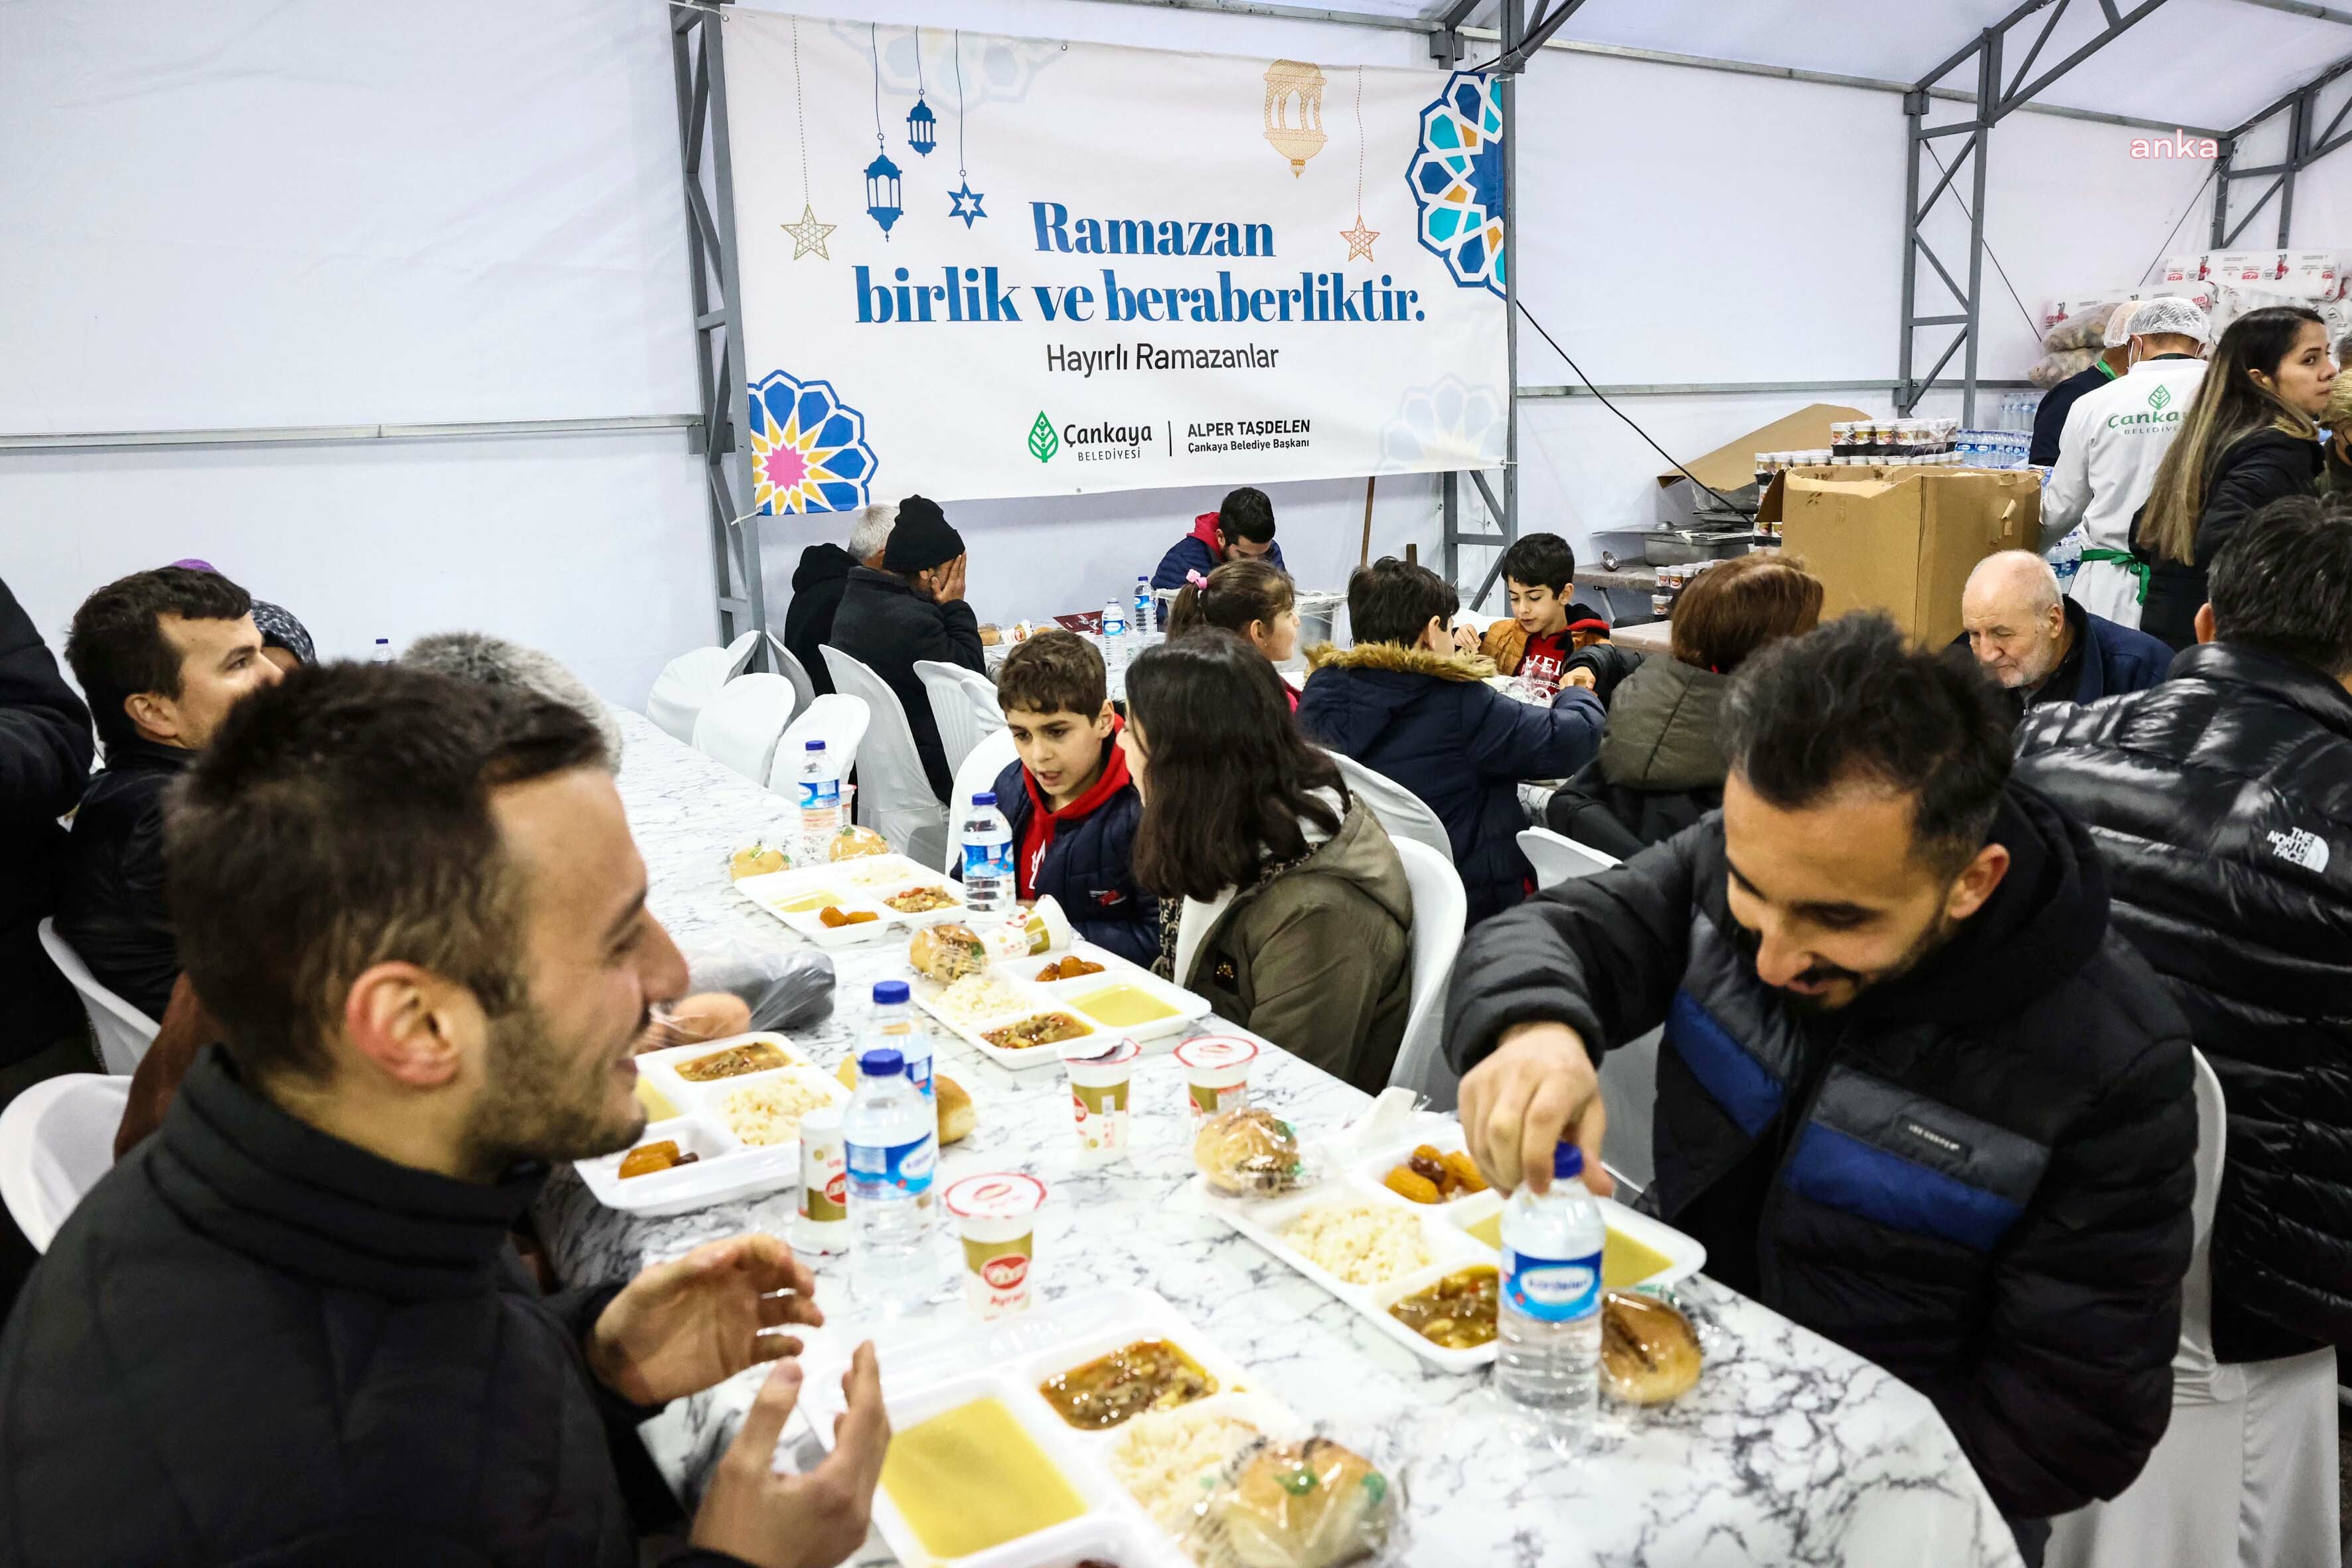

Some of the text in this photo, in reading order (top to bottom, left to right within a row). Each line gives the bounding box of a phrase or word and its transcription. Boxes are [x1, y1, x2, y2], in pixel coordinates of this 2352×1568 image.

[1028, 201, 1277, 258] Ramazan
[852, 266, 1425, 323] birlik ve beraberliktir.
[1047, 343, 1279, 378] Hayırlı Ramazanlar
[1188, 419, 1310, 437] ALPER TAŞDELEN
[2108, 411, 2189, 430] Çanka
[1063, 422, 1152, 447] Çankaya
[1077, 447, 1141, 462] BELEDİYESİ
[1188, 438, 1310, 453] Çankaya Belediye Başkanı
[2266, 830, 2309, 854] NORTH
[2292, 826, 2316, 843] THE
[2272, 844, 2305, 864] FACE
